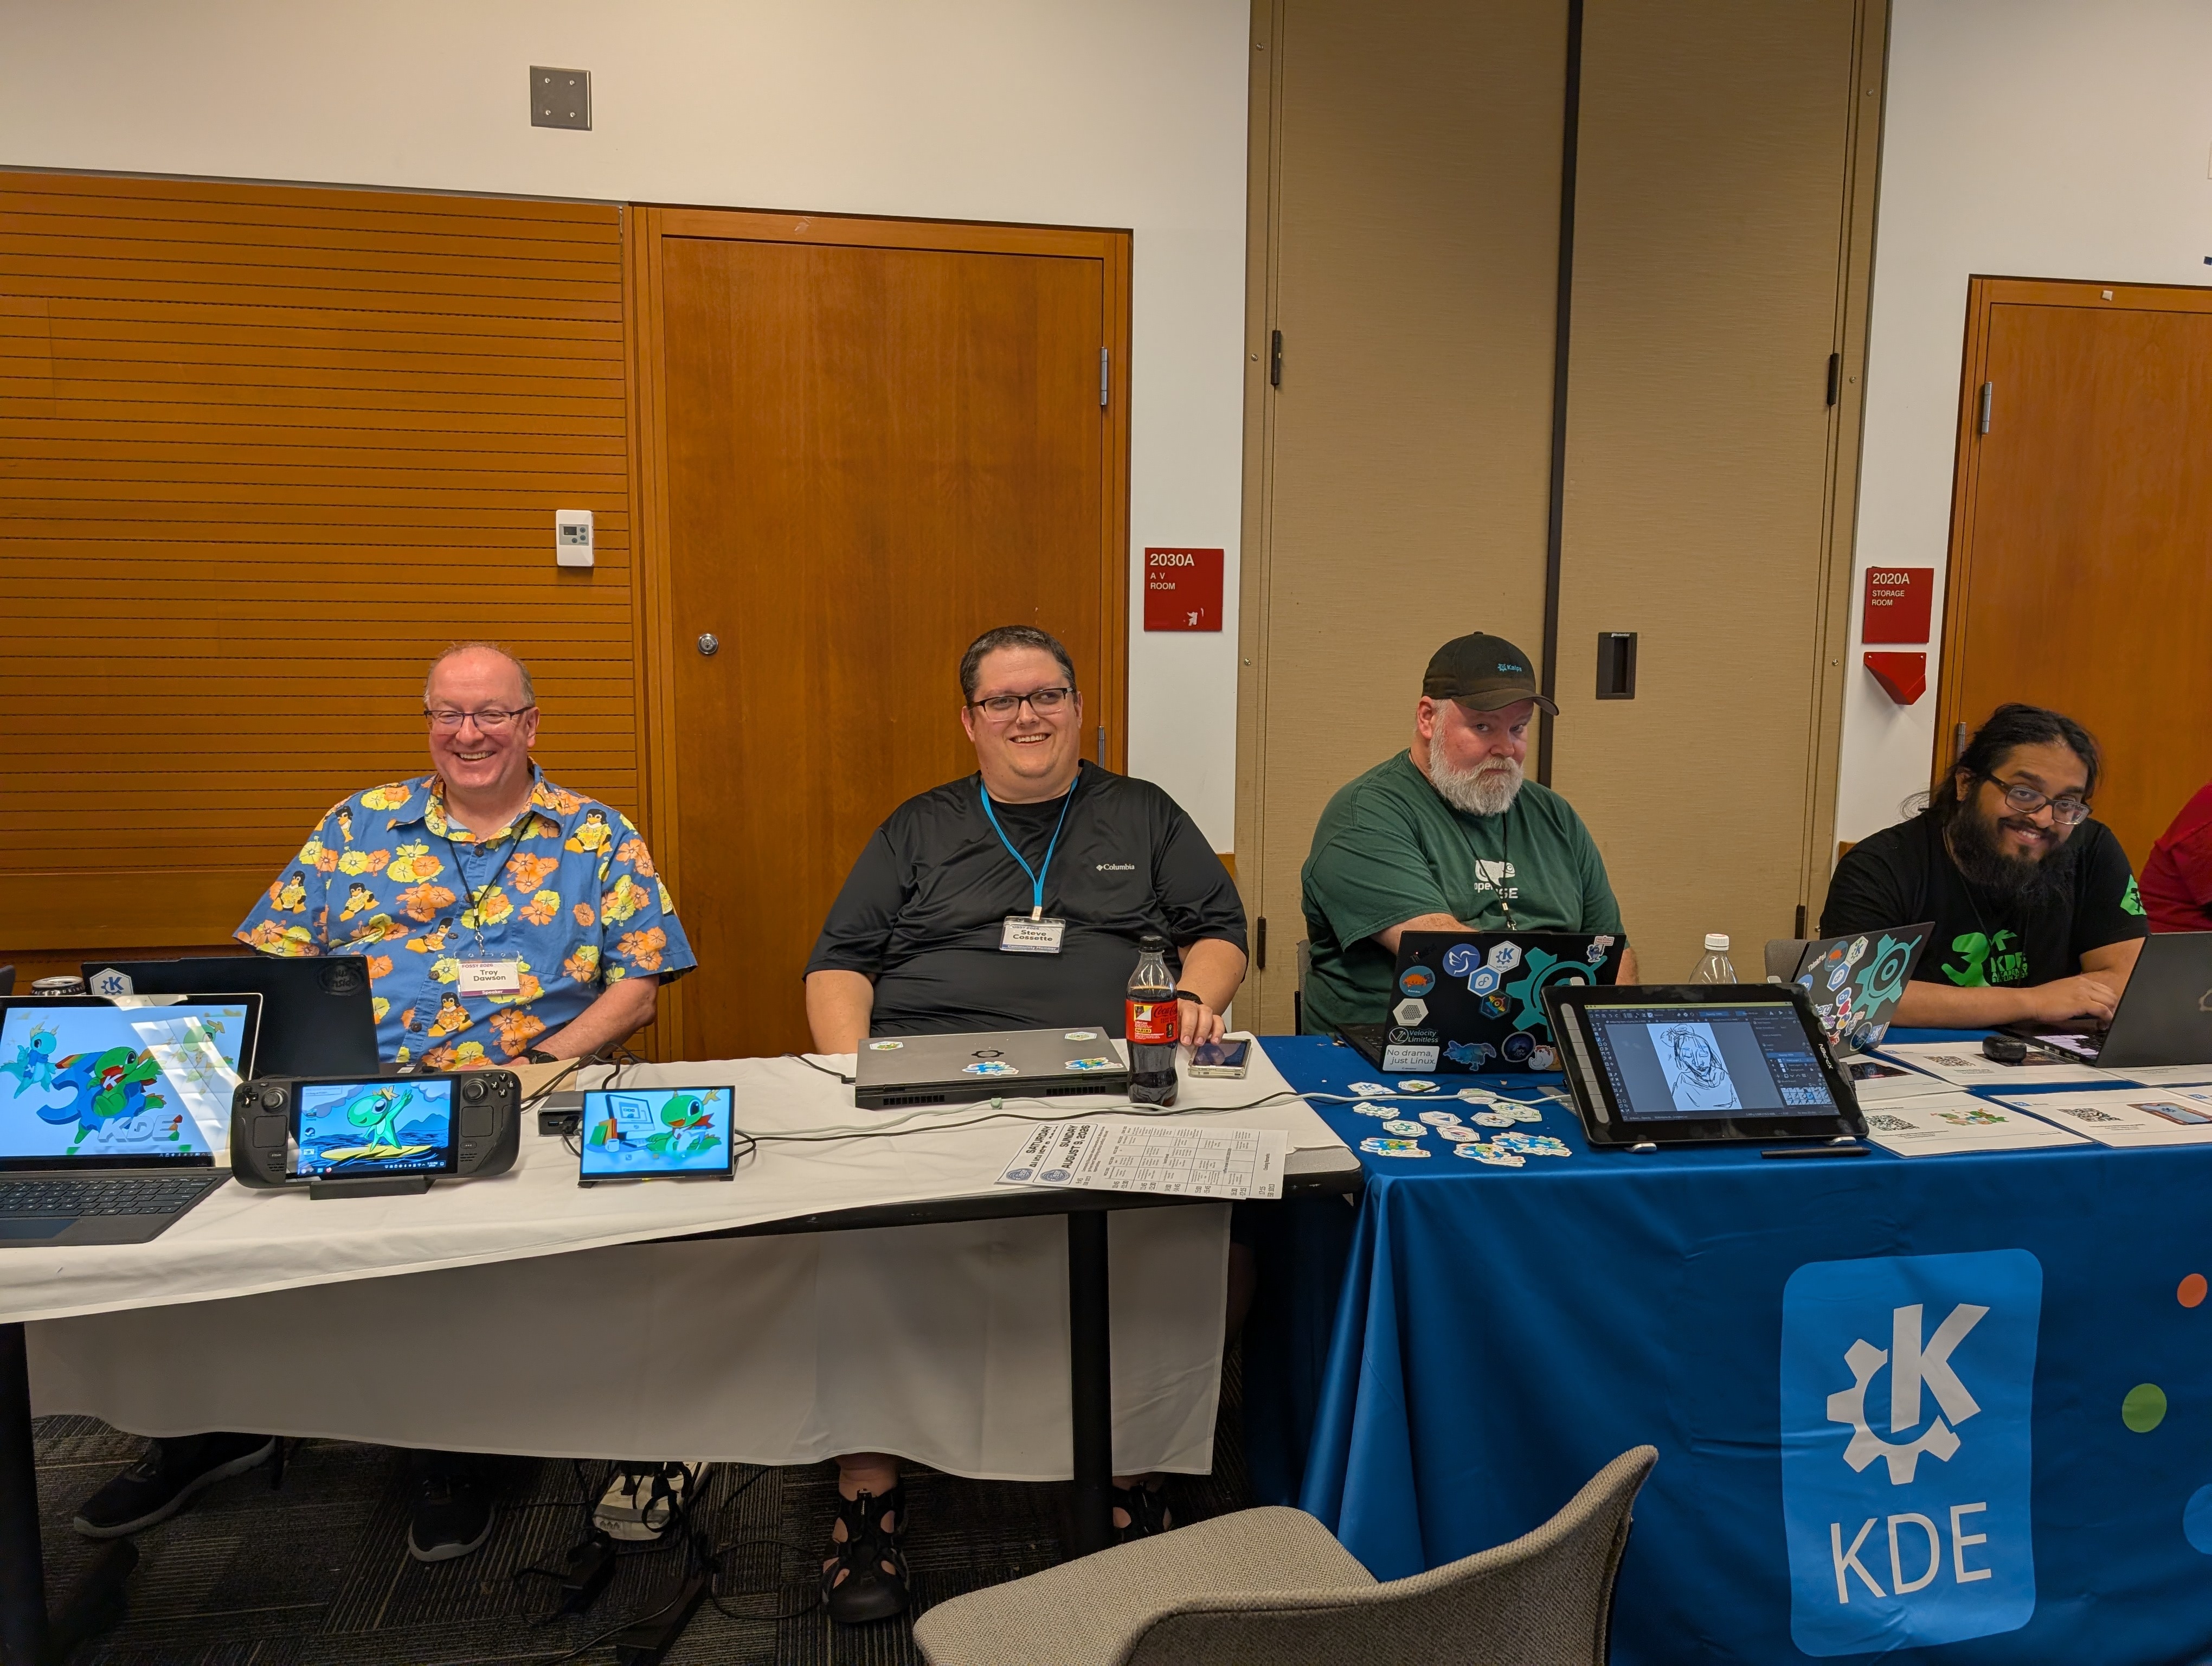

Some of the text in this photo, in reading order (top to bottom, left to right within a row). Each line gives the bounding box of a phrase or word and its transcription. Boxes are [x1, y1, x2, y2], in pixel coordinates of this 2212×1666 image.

[1150, 553, 1195, 566] 2030A
[1872, 573, 1910, 585] 2020A
[1808, 951, 1827, 972] ThinkPad
[98, 1114, 183, 1143] KDE
[1026, 1125, 1053, 1154] SATURDAY
[1059, 1125, 1078, 1148] SUNDAY
[1061, 1145, 1081, 1169] AUGUST
[1076, 1125, 1091, 1139] 2026
[1830, 1501, 1992, 1604] KDE
